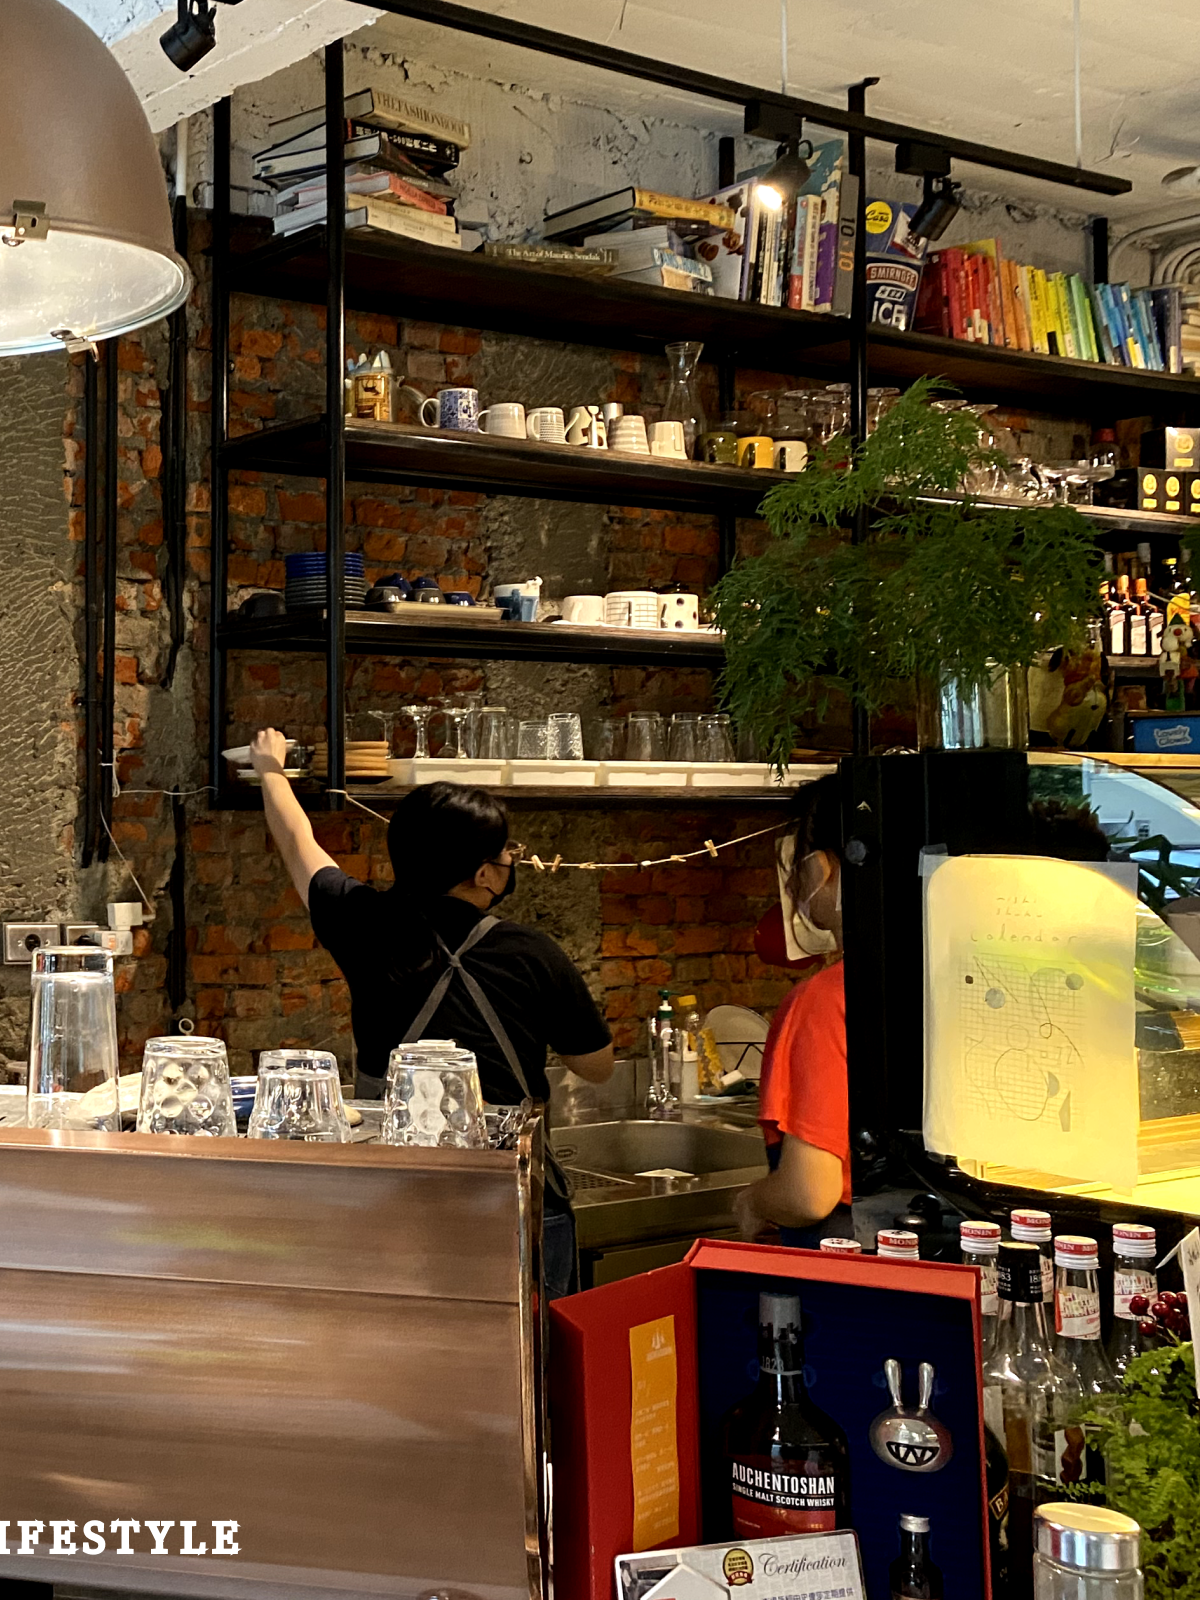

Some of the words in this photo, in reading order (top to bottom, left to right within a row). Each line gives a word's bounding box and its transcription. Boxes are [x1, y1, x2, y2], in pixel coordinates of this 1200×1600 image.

[840, 217, 855, 238] 10
[838, 251, 855, 271] 10
[870, 266, 916, 288] SMIRNOFF
[871, 300, 907, 328] ICE
[731, 1462, 835, 1495] AUCHENTOSHAN
[731, 1482, 754, 1498] SINGLE
[755, 1491, 774, 1503] MALT
[775, 1495, 806, 1507] SCOTCH
[807, 1497, 835, 1507] WHISKY
[758, 1552, 848, 1581] Certification
